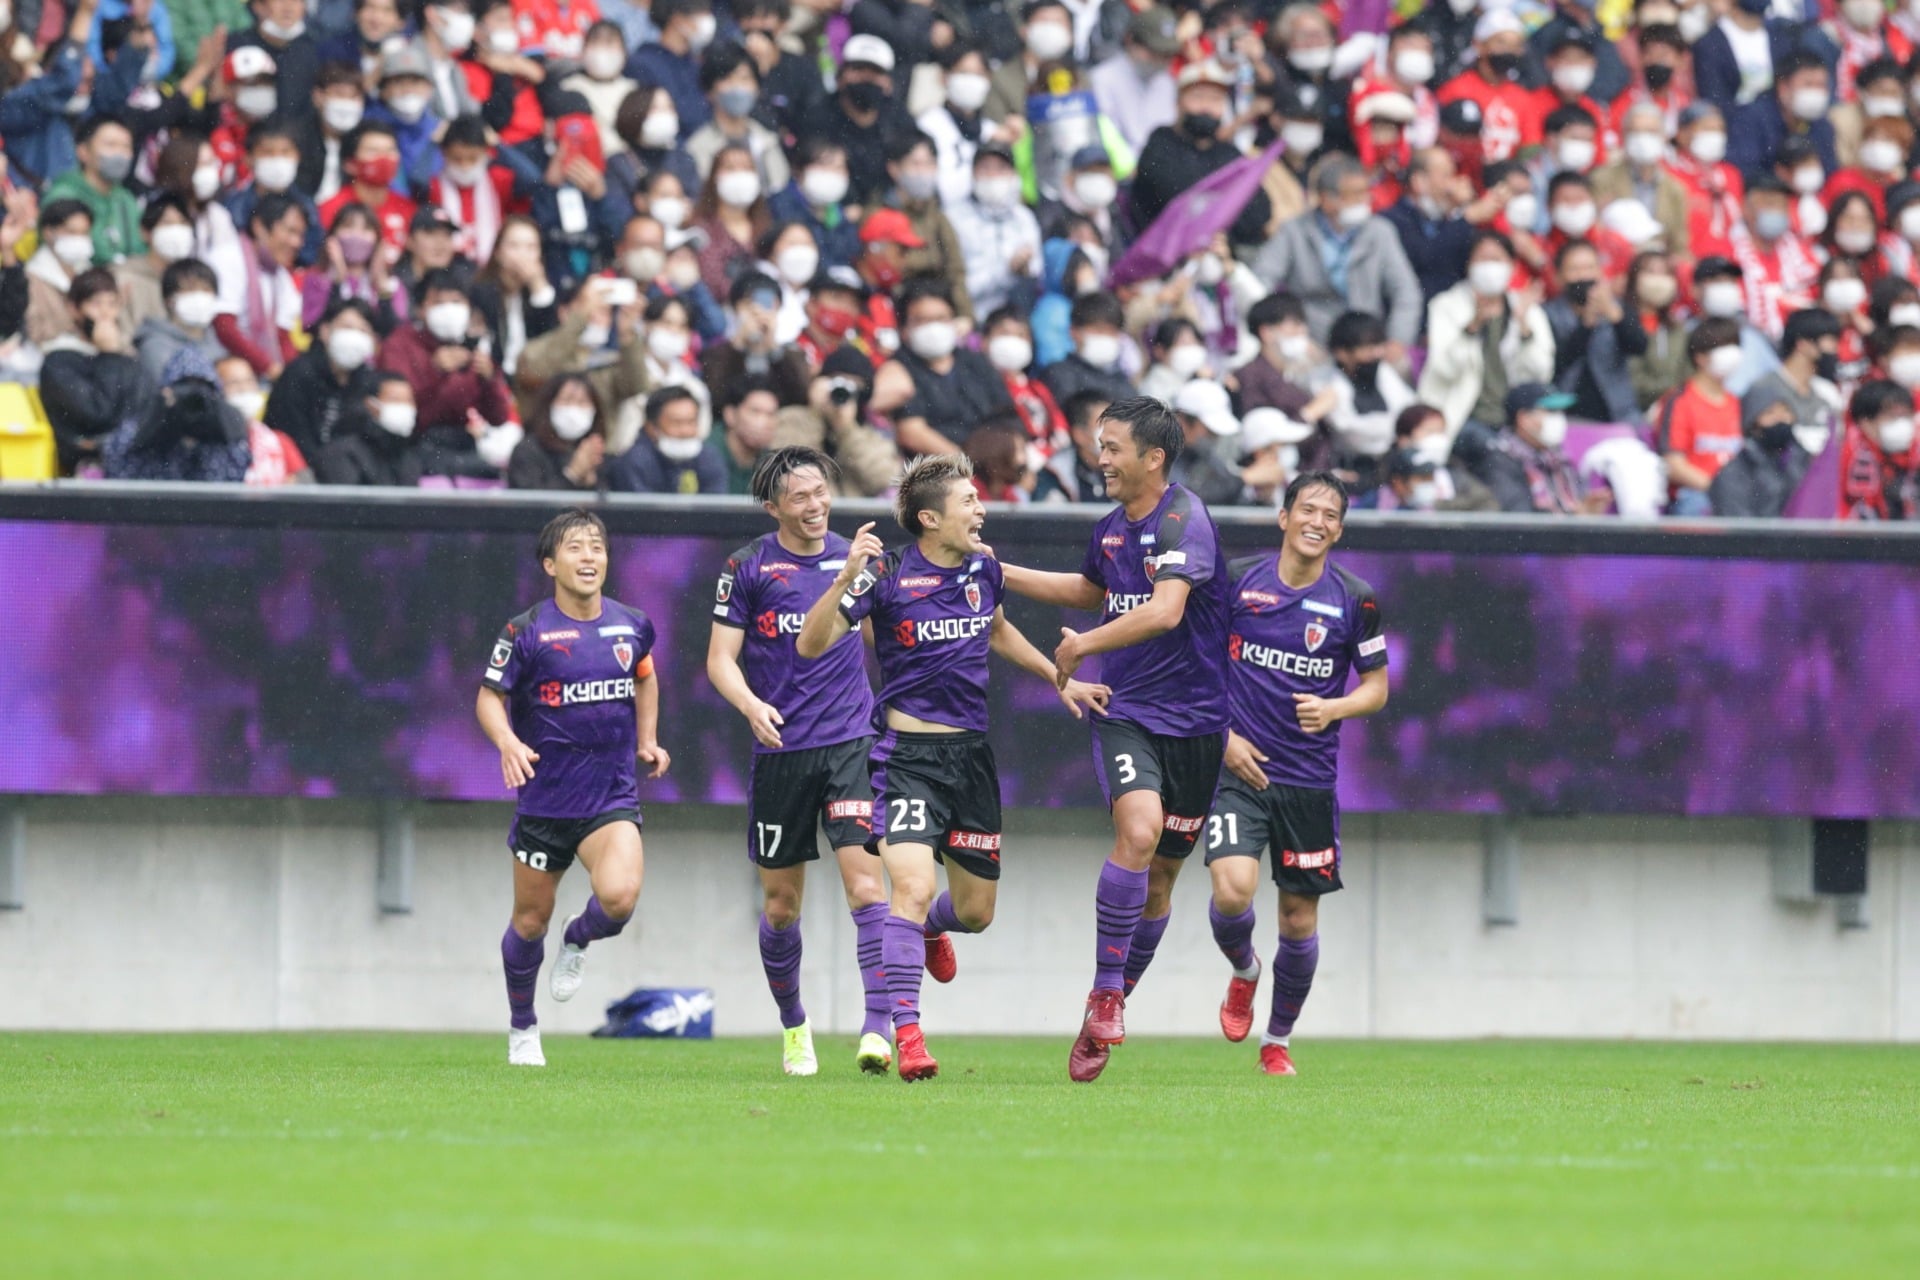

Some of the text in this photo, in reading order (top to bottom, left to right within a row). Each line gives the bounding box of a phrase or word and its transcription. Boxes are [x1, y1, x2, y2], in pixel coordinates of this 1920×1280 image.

[909, 578, 940, 586] WACOAL
[917, 616, 993, 641] KYOCE
[1242, 641, 1334, 678] KYOCERA
[563, 678, 635, 703] KYOCER
[1115, 753, 1137, 784] 3
[890, 799, 926, 833] 23
[1208, 812, 1238, 849] 31
[757, 821, 782, 858] 17
